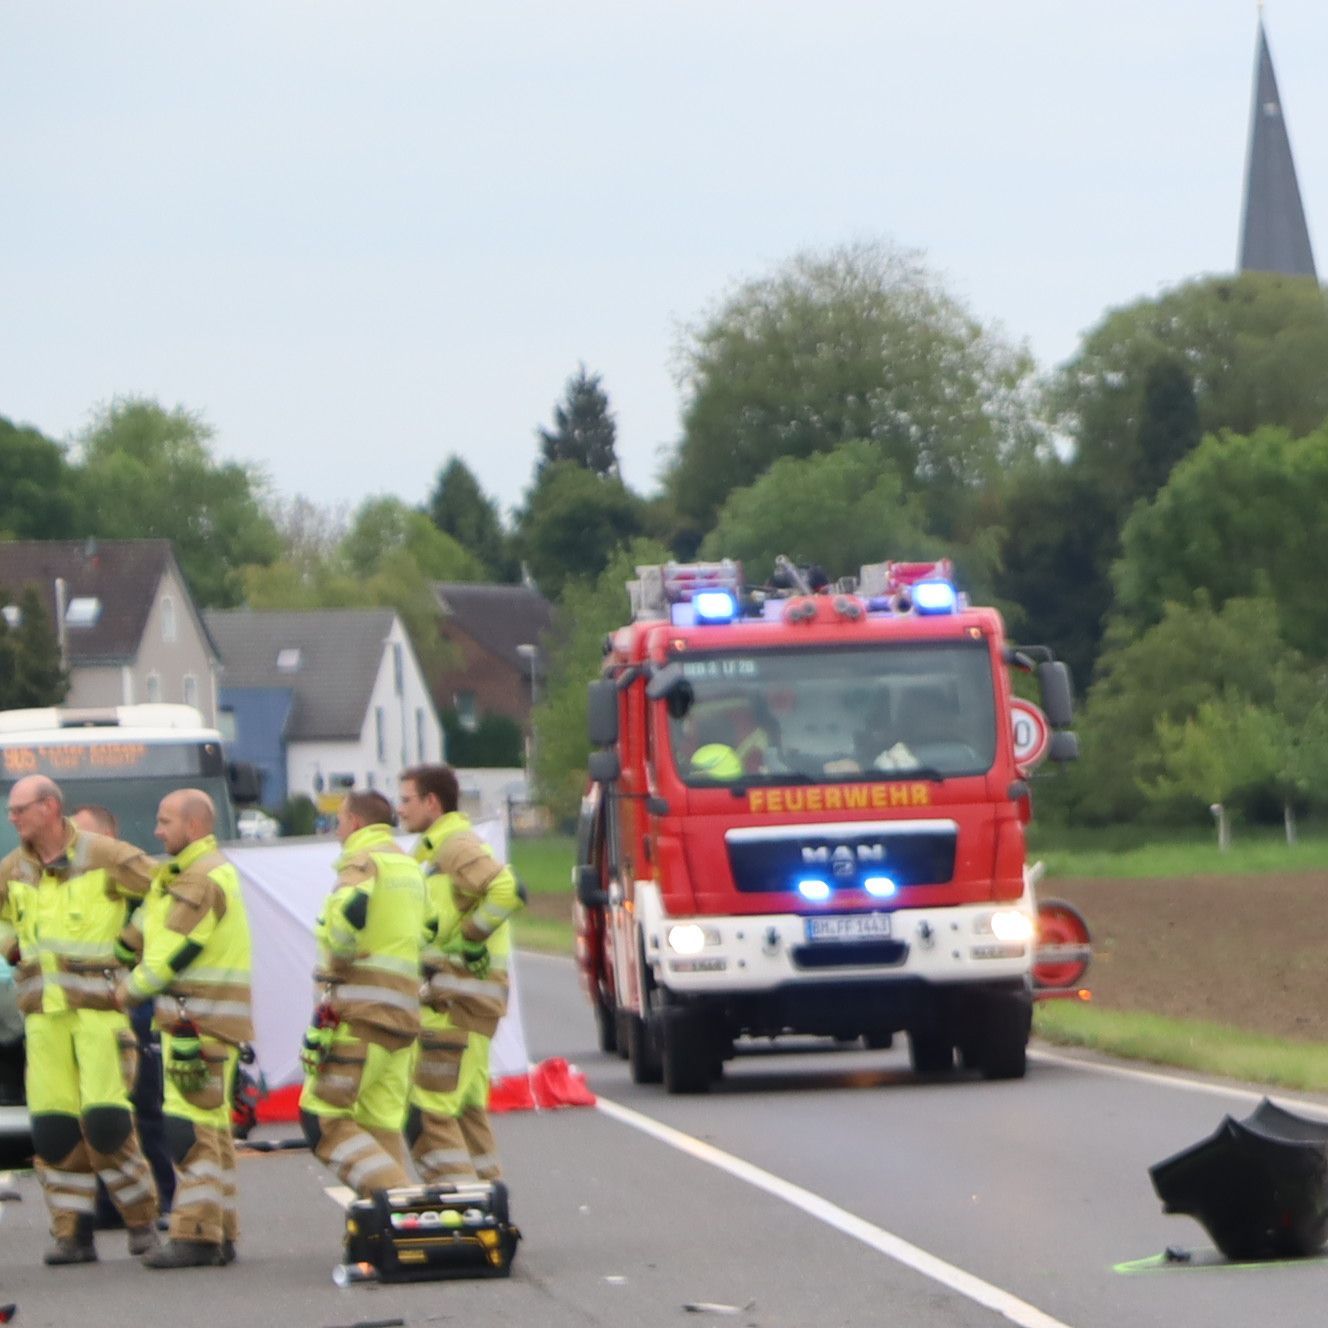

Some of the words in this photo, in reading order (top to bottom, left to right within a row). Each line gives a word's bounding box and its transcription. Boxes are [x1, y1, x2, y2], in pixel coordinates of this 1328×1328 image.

[1014, 719, 1030, 747] 0
[750, 783, 928, 812] FEUERWEHR
[801, 844, 884, 862] MAN
